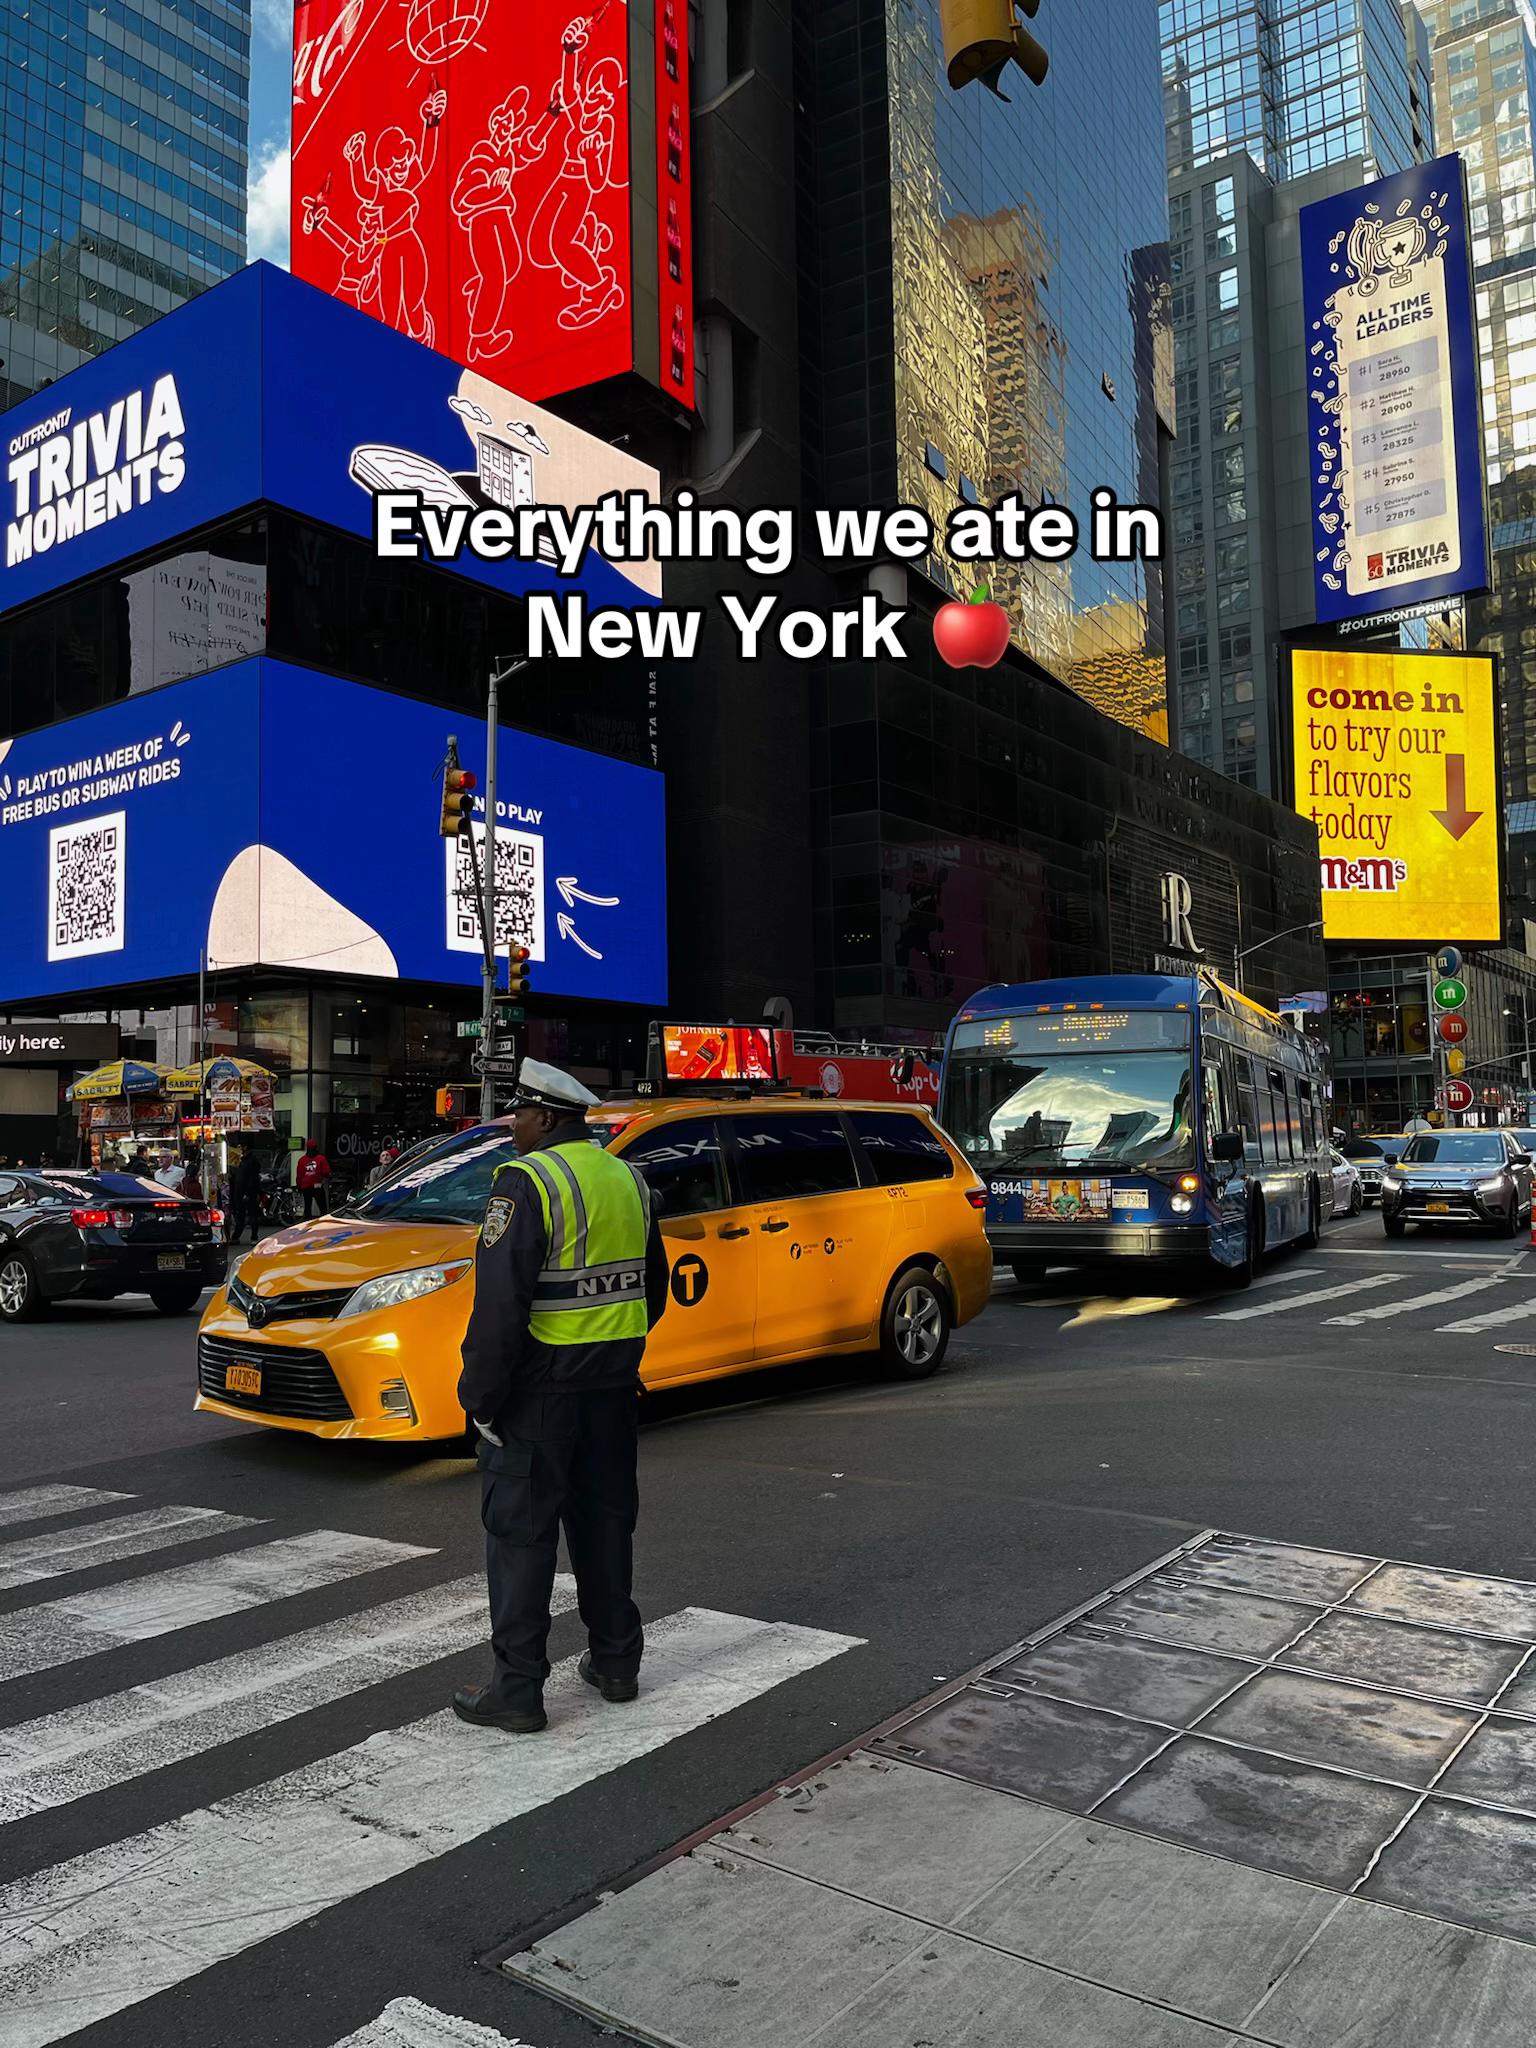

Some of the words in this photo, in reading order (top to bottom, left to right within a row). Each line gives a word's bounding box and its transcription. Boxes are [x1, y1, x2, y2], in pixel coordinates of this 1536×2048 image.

[1356, 308, 1388, 327] ALL
[1389, 292, 1431, 315] TIME
[1356, 307, 1434, 341] LEADERS
[1359, 363, 1372, 377] #1
[1379, 366, 1410, 382] 28950
[1359, 399, 1376, 410] #2
[1381, 401, 1413, 416] 28900
[8, 373, 186, 518] TRIVIA
[1361, 433, 1376, 445] #3
[1383, 436, 1414, 451] 28325
[1363, 468, 1378, 480] #4
[1384, 472, 1415, 487] 27950
[6, 441, 186, 568] MOMENTS
[1364, 503, 1380, 515] #5
[1386, 508, 1416, 523] 27875
[1386, 541, 1449, 566] TRIVIA
[1386, 554, 1450, 576] MOMENTS
[1339, 597, 1461, 635] #OUTFRONTPRIME
[1306, 686, 1415, 712] come
[1420, 681, 1465, 714] in
[1306, 716, 1338, 751] to
[1343, 718, 1392, 763] try
[1398, 726, 1446, 755] our
[17, 772, 49, 798] PLAY
[49, 767, 67, 788] TO
[67, 758, 92, 783] WIN
[92, 756, 104, 776] A
[105, 743, 143, 772] WEEK
[143, 736, 164, 761] OF
[1308, 758, 1412, 800] flavors
[2, 802, 34, 826] FREE
[34, 794, 61, 817] BUS
[62, 787, 81, 810] OR
[81, 770, 137, 803] SUBWAY
[138, 758, 182, 788] RIDES
[508, 803, 543, 826] PLAY
[1308, 802, 1393, 851] today
[1442, 987, 1457, 1000] m
[1450, 1021, 1463, 1033] m
[497, 1063, 512, 1072] WAY
[1450, 1089, 1464, 1102] m
[336, 1133, 381, 1156] Olive
[887, 1186, 909, 1199] 4P72
[990, 1181, 1023, 1195] 9844
[678, 1263, 700, 1301] T
